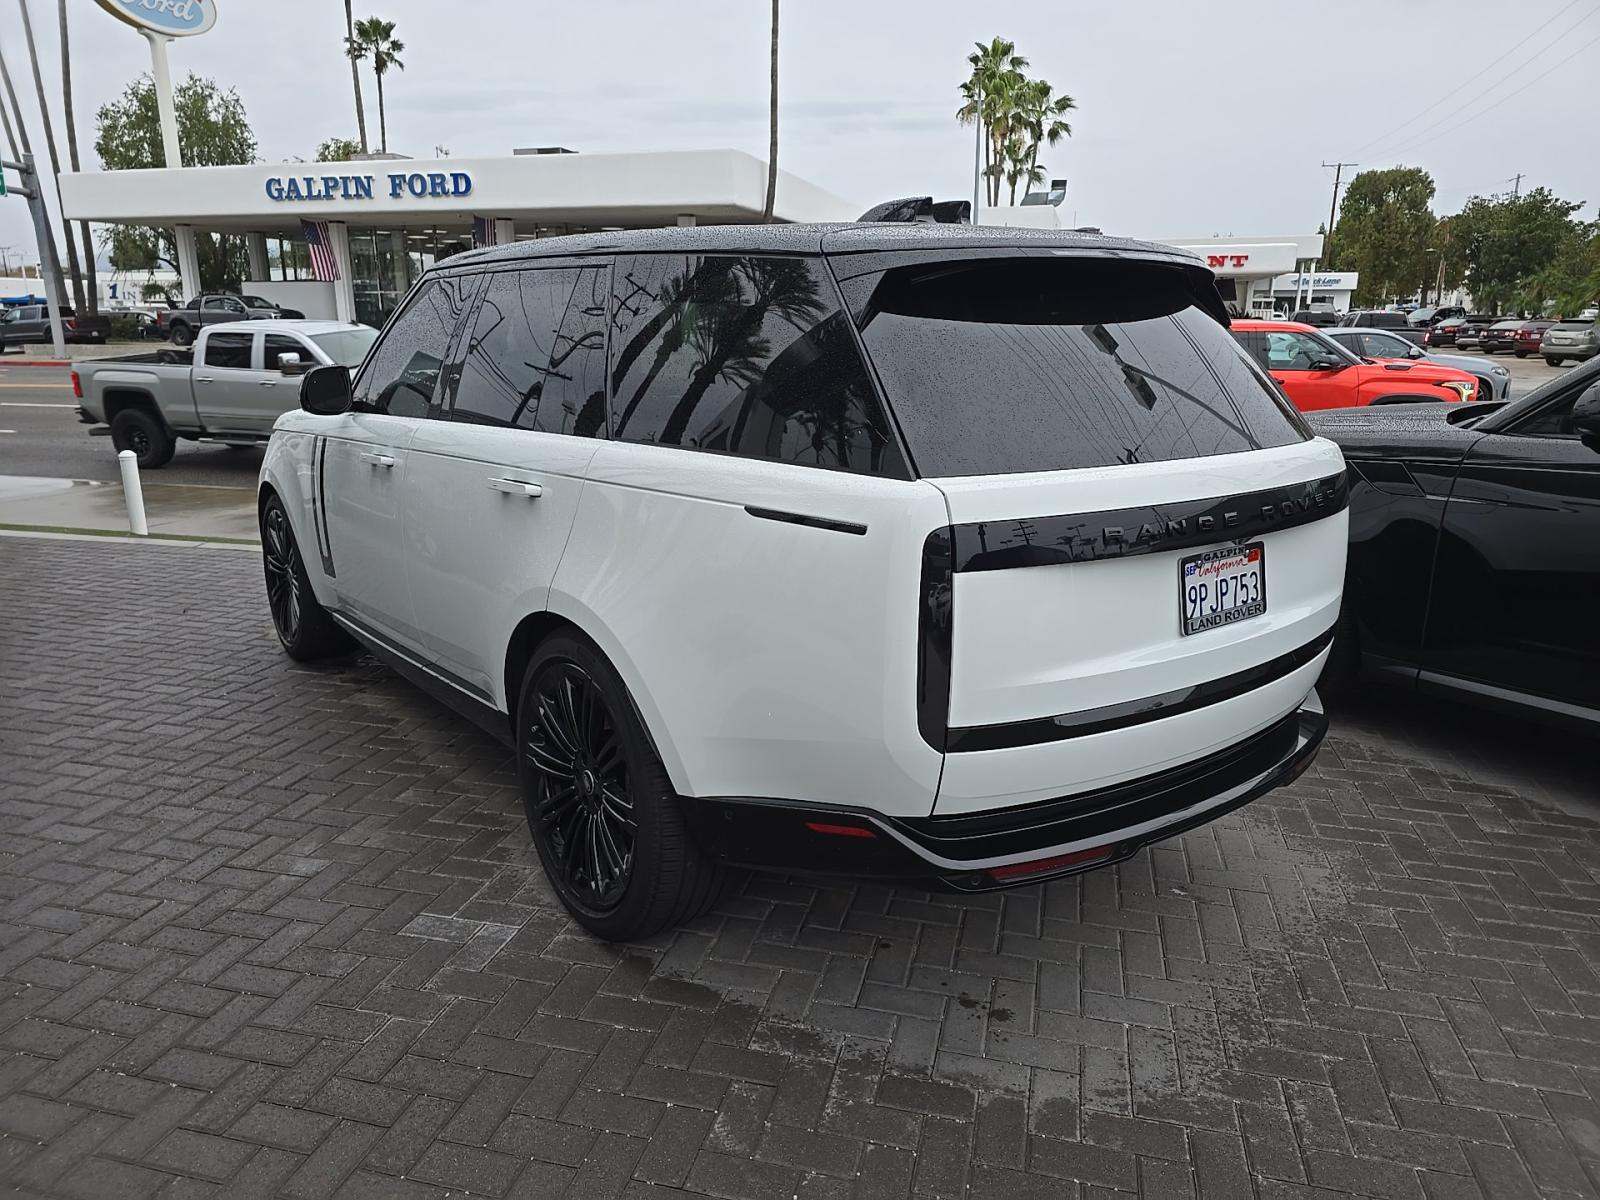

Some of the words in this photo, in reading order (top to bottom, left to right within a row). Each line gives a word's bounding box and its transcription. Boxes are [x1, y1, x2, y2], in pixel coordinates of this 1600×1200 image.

[121, 0, 194, 21] ord
[265, 175, 375, 201] GALPIN
[388, 172, 473, 198] FORD
[1102, 510, 1239, 547] RANGE
[1203, 545, 1247, 562] GALPIN
[1188, 571, 1259, 619] 9PJP753
[1191, 614, 1222, 632] LAND
[1224, 602, 1263, 623] ROVER
